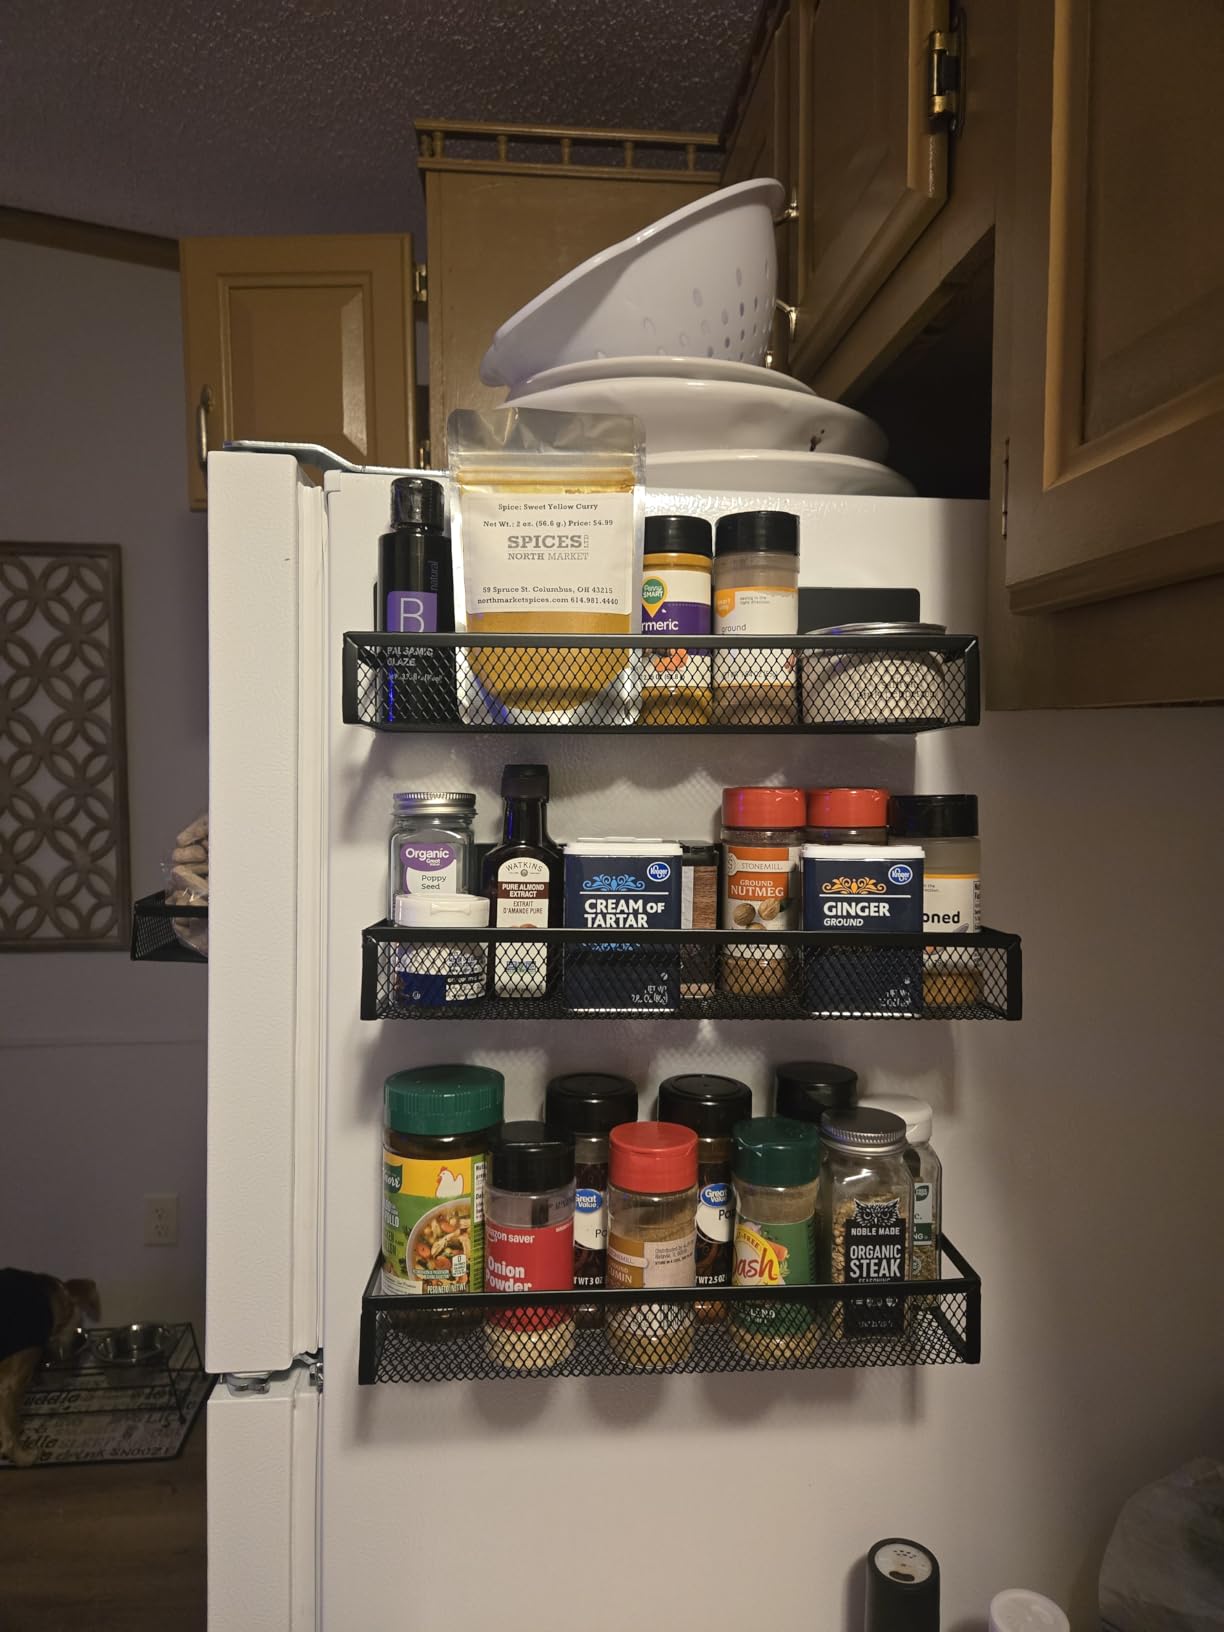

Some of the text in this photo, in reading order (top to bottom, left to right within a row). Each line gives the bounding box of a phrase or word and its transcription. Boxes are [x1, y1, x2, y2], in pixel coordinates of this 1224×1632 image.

[507, 535, 582, 549] SPICES
[548, 552, 589, 560] MARKET
[492, 586, 519, 594] Spruce
[477, 596, 619, 605] northmarketspices.com 614.981.4440
[400, 597, 424, 632] B
[721, 624, 747, 635] ground
[405, 848, 450, 861] Organic
[506, 862, 543, 872] WATKINS
[650, 865, 669, 878] Kroger
[421, 875, 447, 885] Poppy
[892, 868, 910, 882] Kroger
[520, 883, 545, 891] ALMOND
[731, 885, 784, 897] NUTMEG
[584, 899, 665, 913] CREAM OF
[823, 902, 891, 917] GINGER
[584, 914, 648, 928] TARTAR
[823, 918, 864, 927] GROUND
[705, 1189, 726, 1199] Great
[879, 1227, 900, 1235] MADE
[508, 1235, 535, 1243] saver
[850, 1245, 901, 1259] ORGANIC
[488, 1256, 525, 1278] Onion
[735, 1247, 778, 1281] ash
[850, 1259, 901, 1277] STEAK
[578, 1277, 588, 1285] WT
[708, 1276, 718, 1284] 2.5
